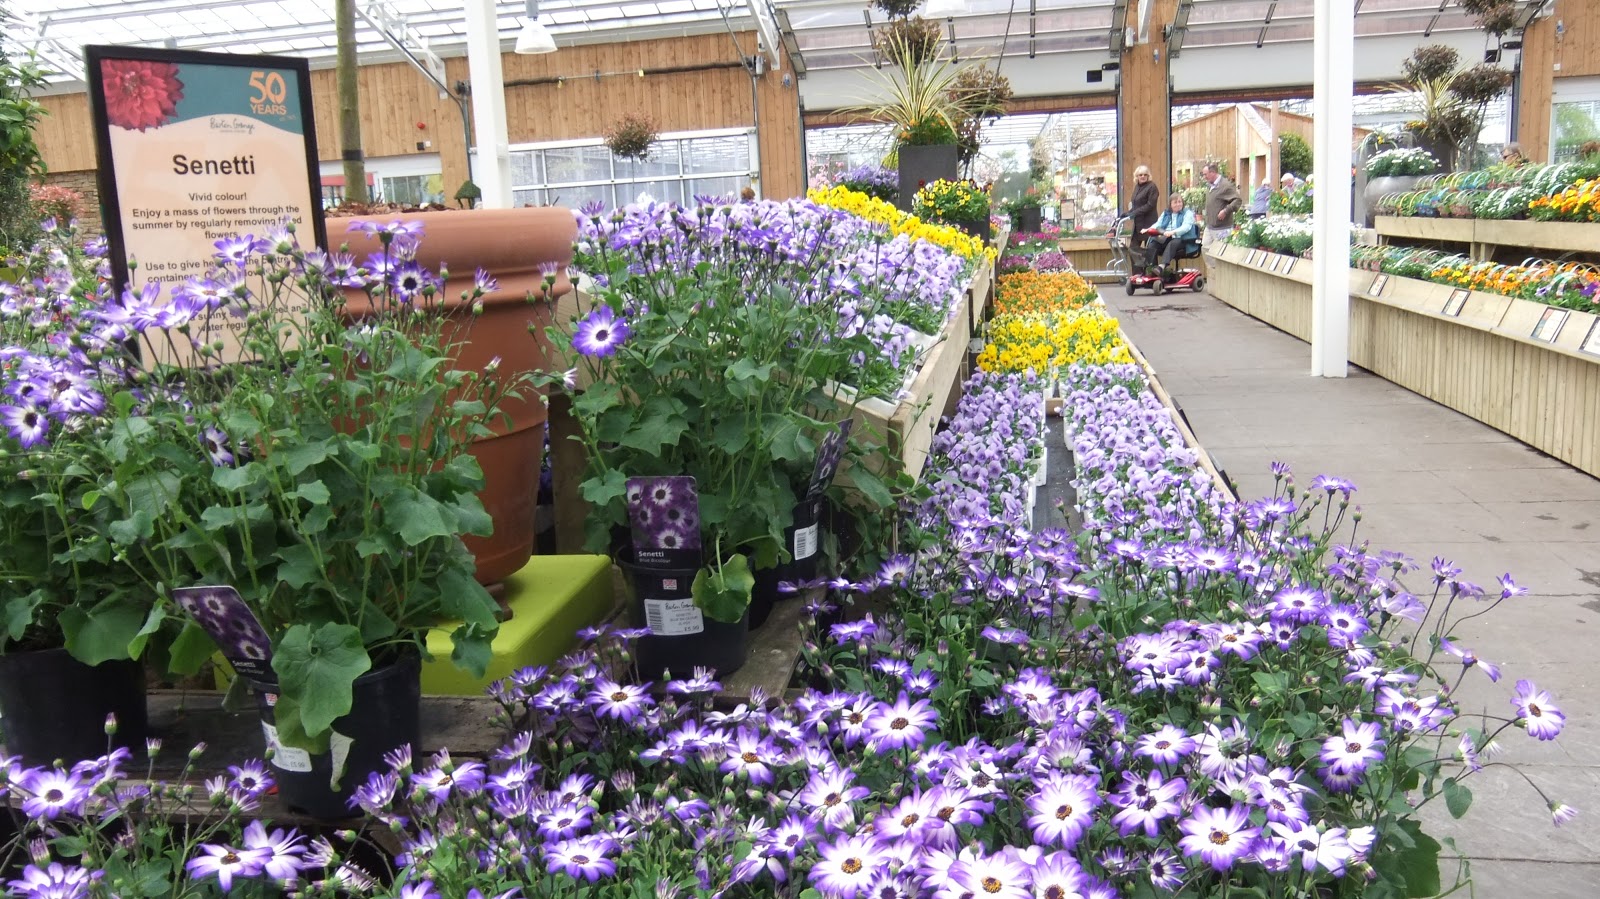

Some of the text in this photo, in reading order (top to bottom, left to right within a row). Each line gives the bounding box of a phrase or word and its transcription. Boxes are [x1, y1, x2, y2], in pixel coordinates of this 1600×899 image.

[248, 71, 287, 104] 50
[250, 103, 287, 115] YEARS
[172, 154, 255, 175] Senetti
[188, 192, 247, 201] Vivid colour!
[132, 205, 300, 219] Enjoy a mass of flowers through the
[132, 215, 302, 230] summer by regularly removing fed
[145, 262, 165, 271] Use
[167, 261, 178, 270] to
[180, 260, 201, 271] give
[147, 272, 198, 283] container
